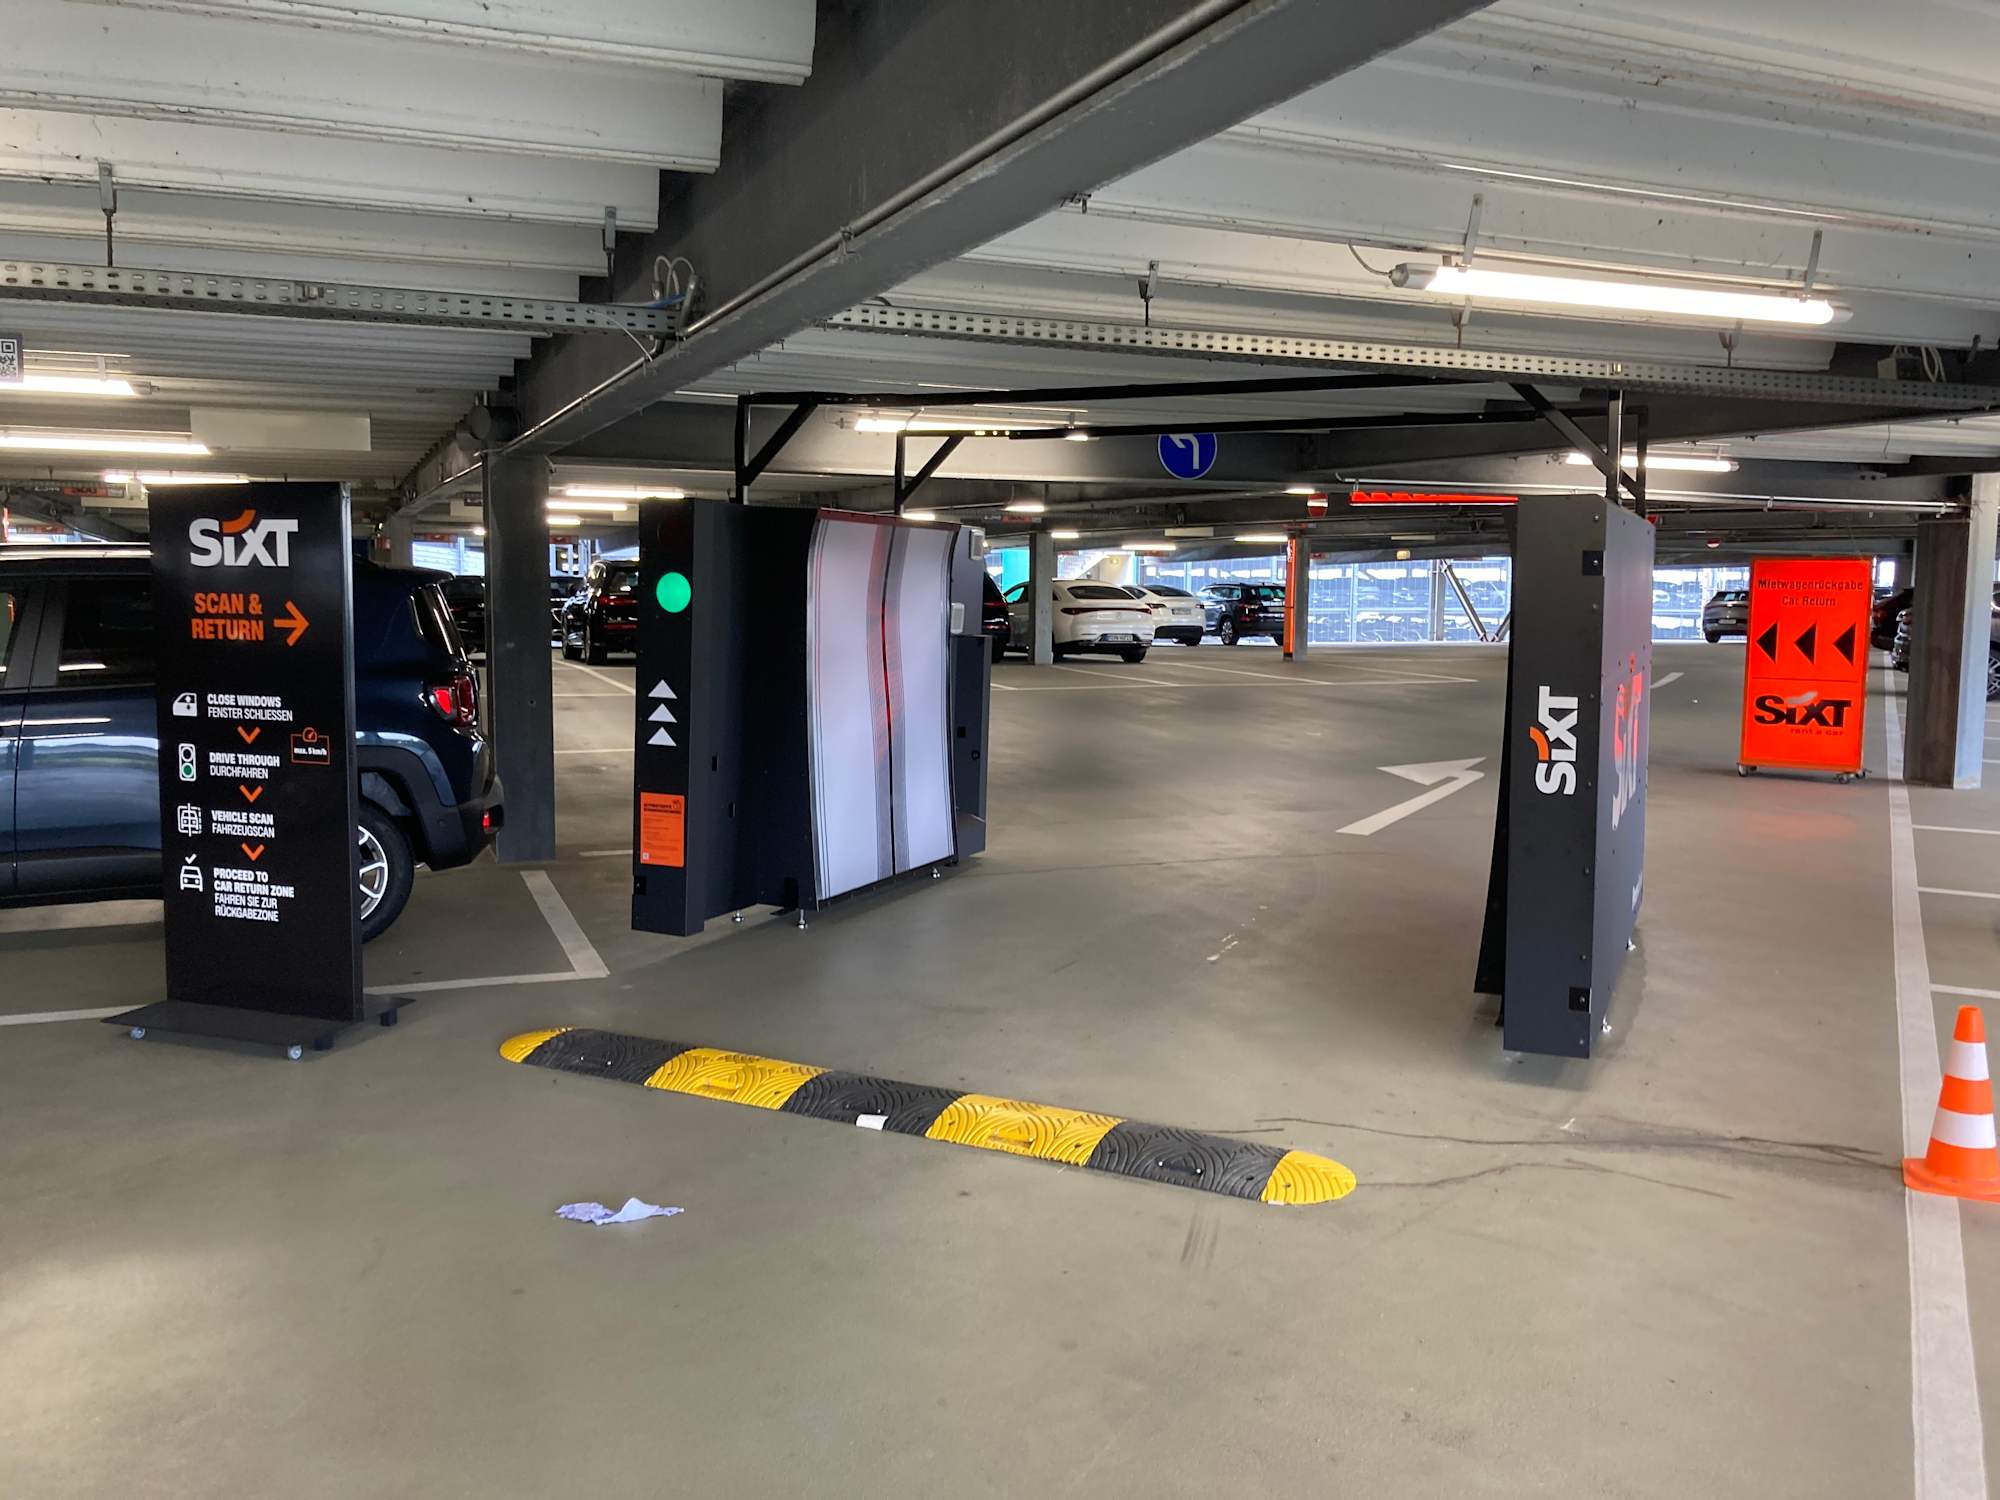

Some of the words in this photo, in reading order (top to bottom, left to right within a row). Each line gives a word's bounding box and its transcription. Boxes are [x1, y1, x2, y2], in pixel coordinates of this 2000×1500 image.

[194, 592, 244, 615] SCAN
[248, 593, 263, 615] &
[1782, 595, 1799, 606] Car
[1803, 596, 1836, 607] Return
[191, 618, 265, 641] RETURN
[207, 693, 236, 706] CLOSE
[236, 694, 282, 708] WINDOWS
[207, 706, 244, 719] FENSTER
[243, 708, 293, 722] SCHLIESSEN
[209, 752, 236, 765] DRIVE
[237, 753, 281, 768] THROUGH
[209, 765, 269, 780] DURCHFAHREN
[211, 810, 248, 824] VEHICLE
[248, 812, 274, 826] SCAN
[212, 823, 276, 839] FAHRZEUGSCAN
[213, 867, 255, 882] PROCEED
[255, 871, 269, 883] TO
[214, 881, 233, 893] CAR
[233, 882, 270, 896] RETURN
[269, 885, 295, 899] ZONE
[214, 893, 246, 906] FAHREN
[246, 896, 260, 908] SIE
[260, 897, 278, 910] ZUR
[215, 904, 280, 923] RÜCKGABEZONE
